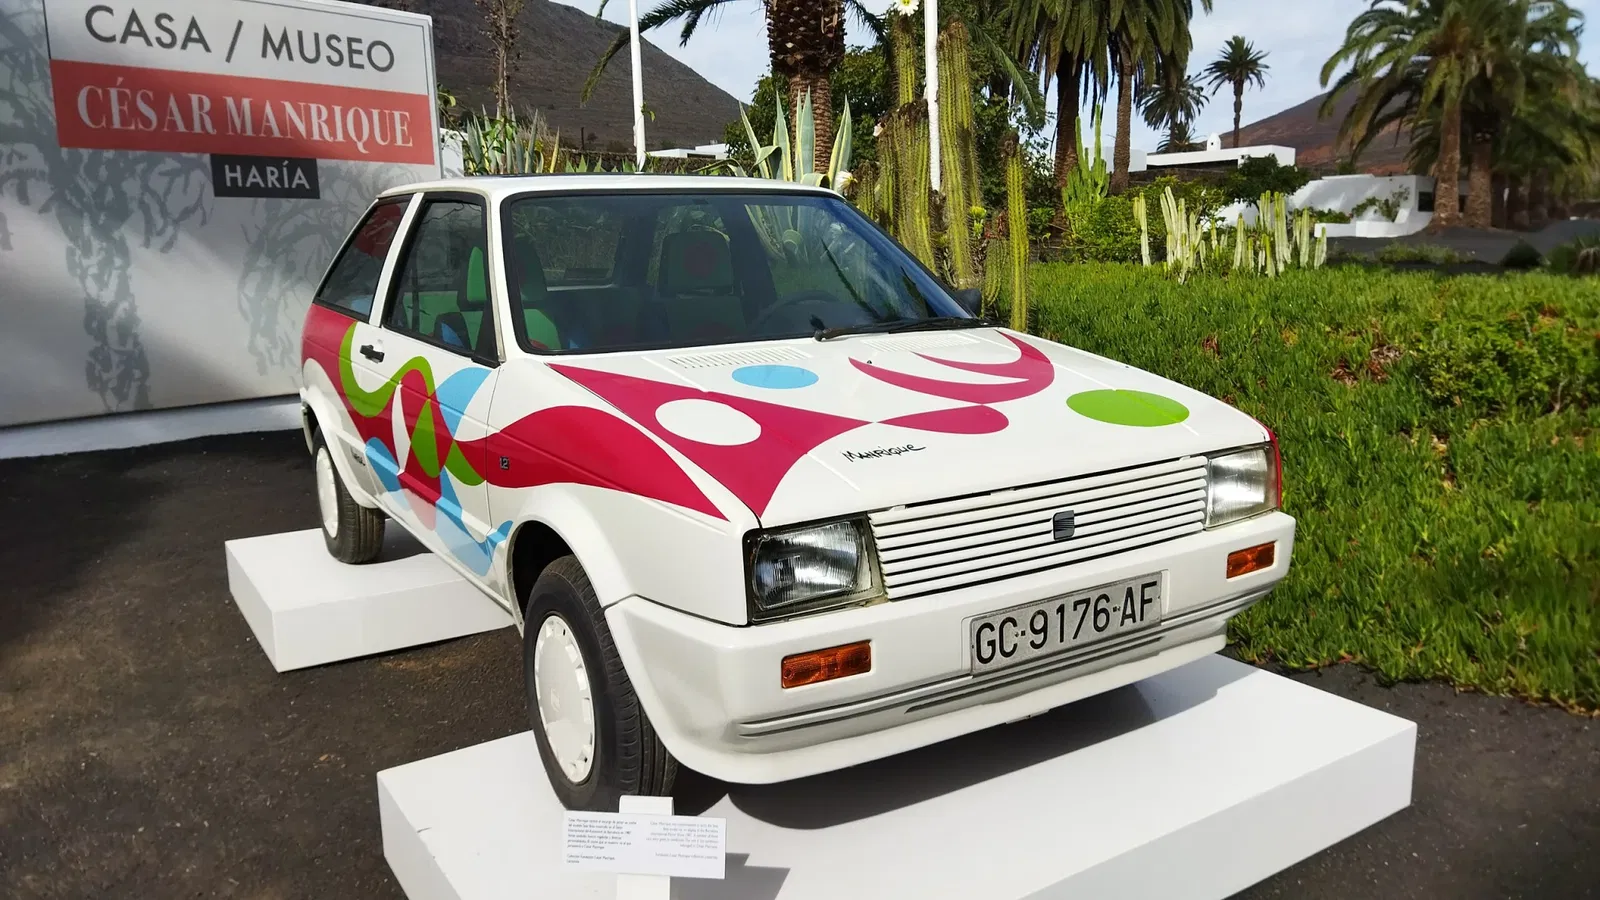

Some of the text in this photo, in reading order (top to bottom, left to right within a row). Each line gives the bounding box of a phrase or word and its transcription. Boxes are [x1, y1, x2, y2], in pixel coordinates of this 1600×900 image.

[85, 5, 395, 73] CASA / MUSEO
[77, 77, 413, 154] CÉSAR MANRIQUE
[224, 160, 310, 190] HARÍA
